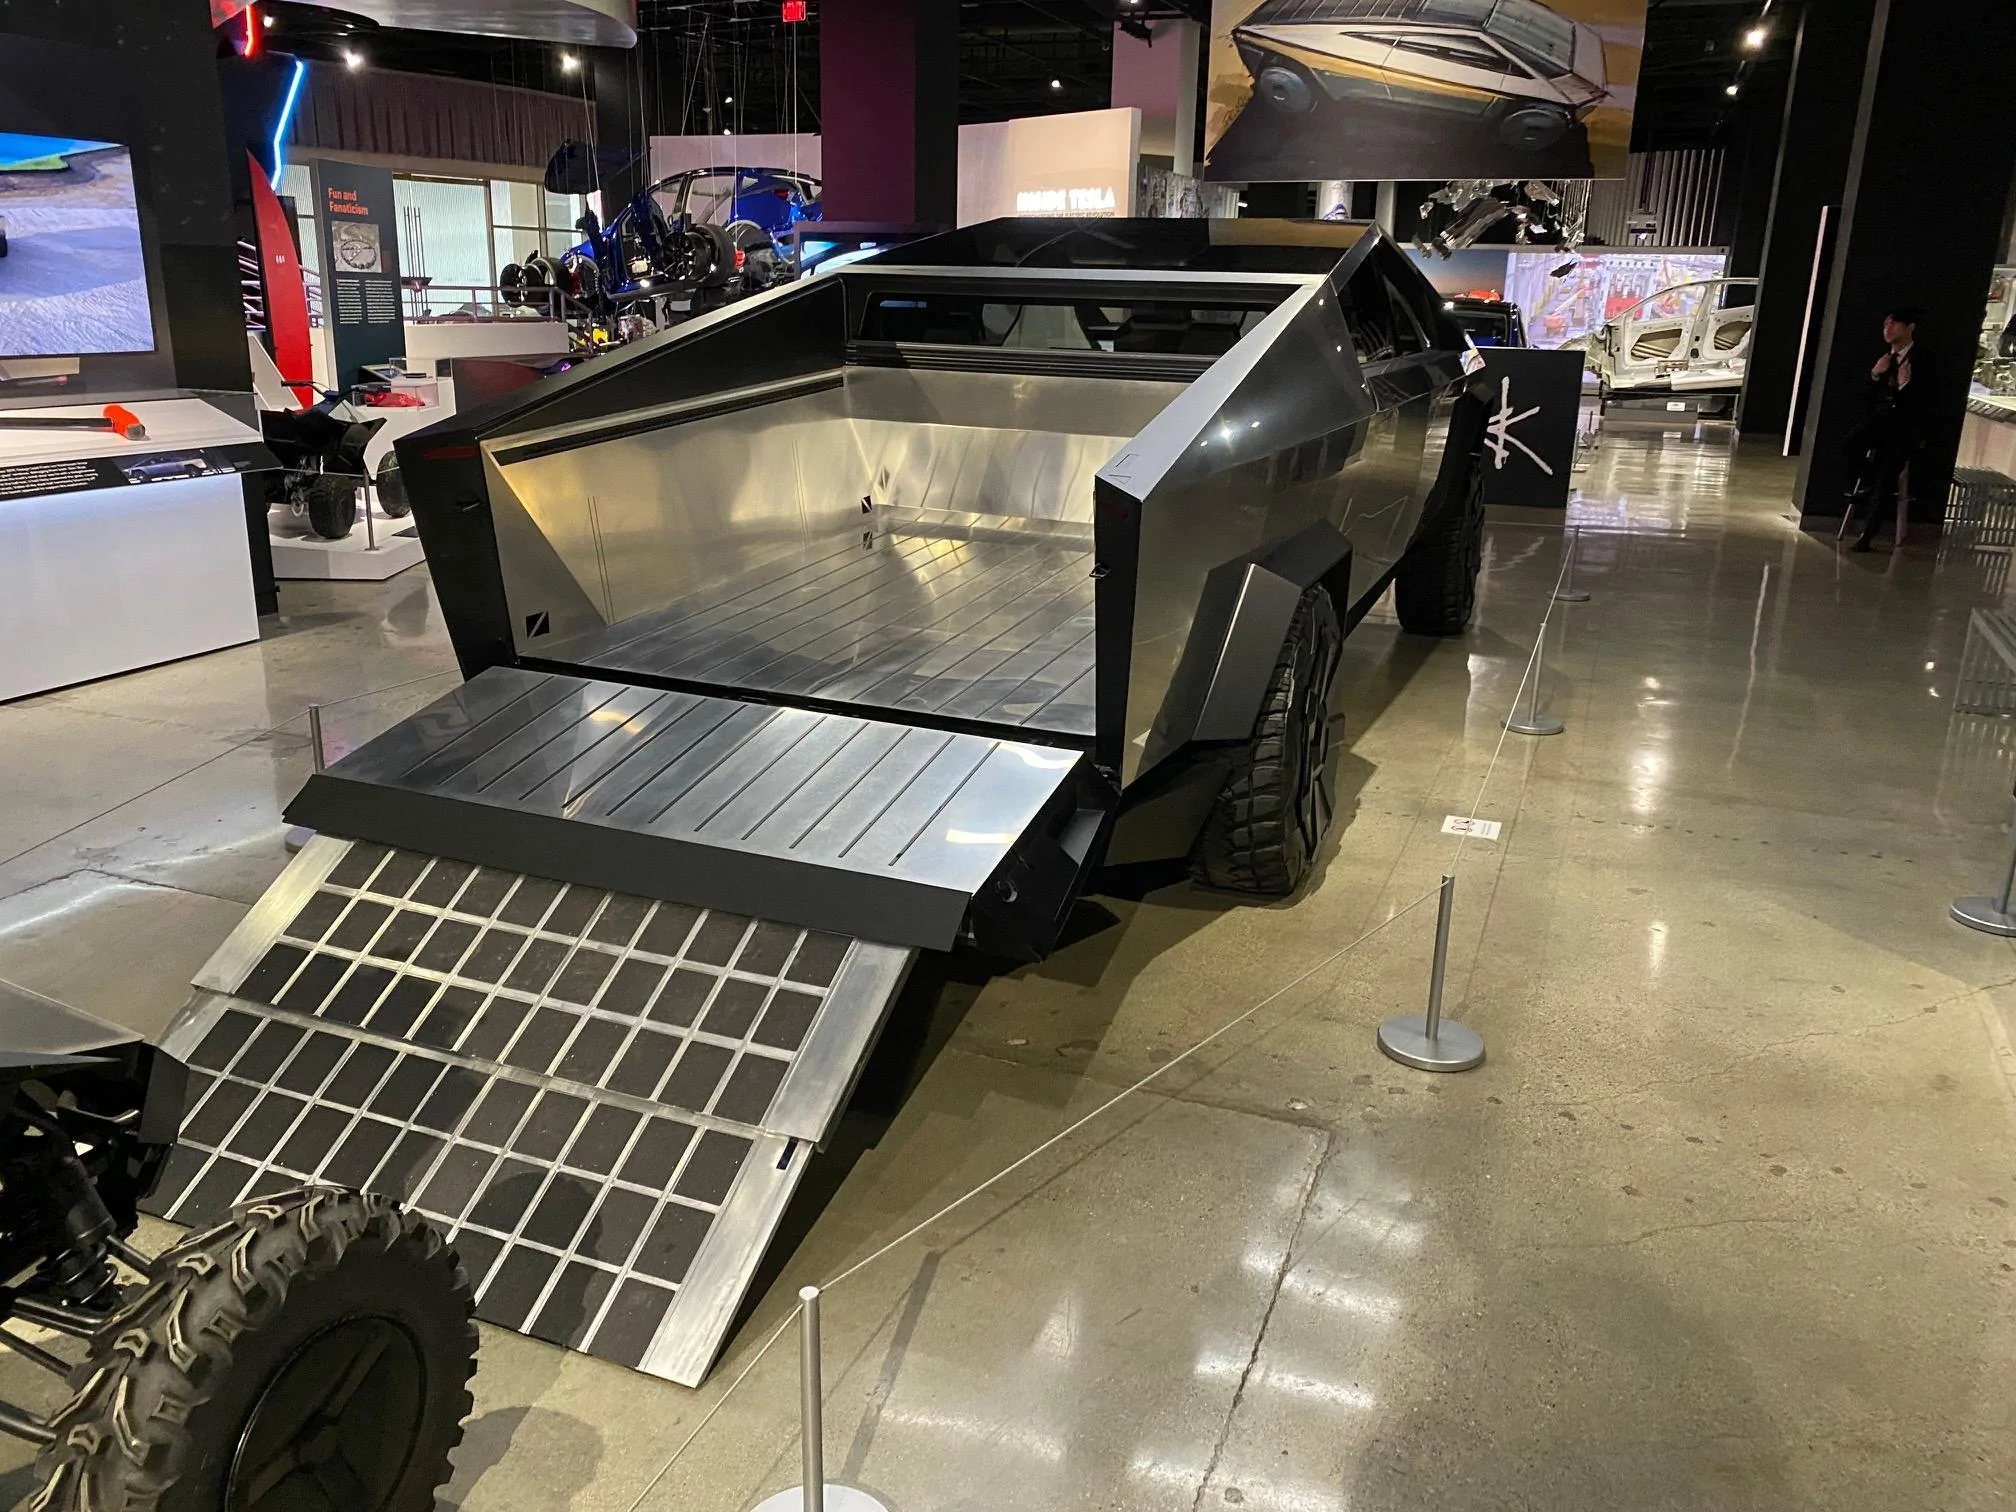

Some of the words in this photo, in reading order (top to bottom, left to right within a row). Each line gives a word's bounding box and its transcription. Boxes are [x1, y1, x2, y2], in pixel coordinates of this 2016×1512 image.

[328, 187, 342, 199] Fun
[342, 190, 357, 201] and
[329, 201, 369, 216] Fanaticism
